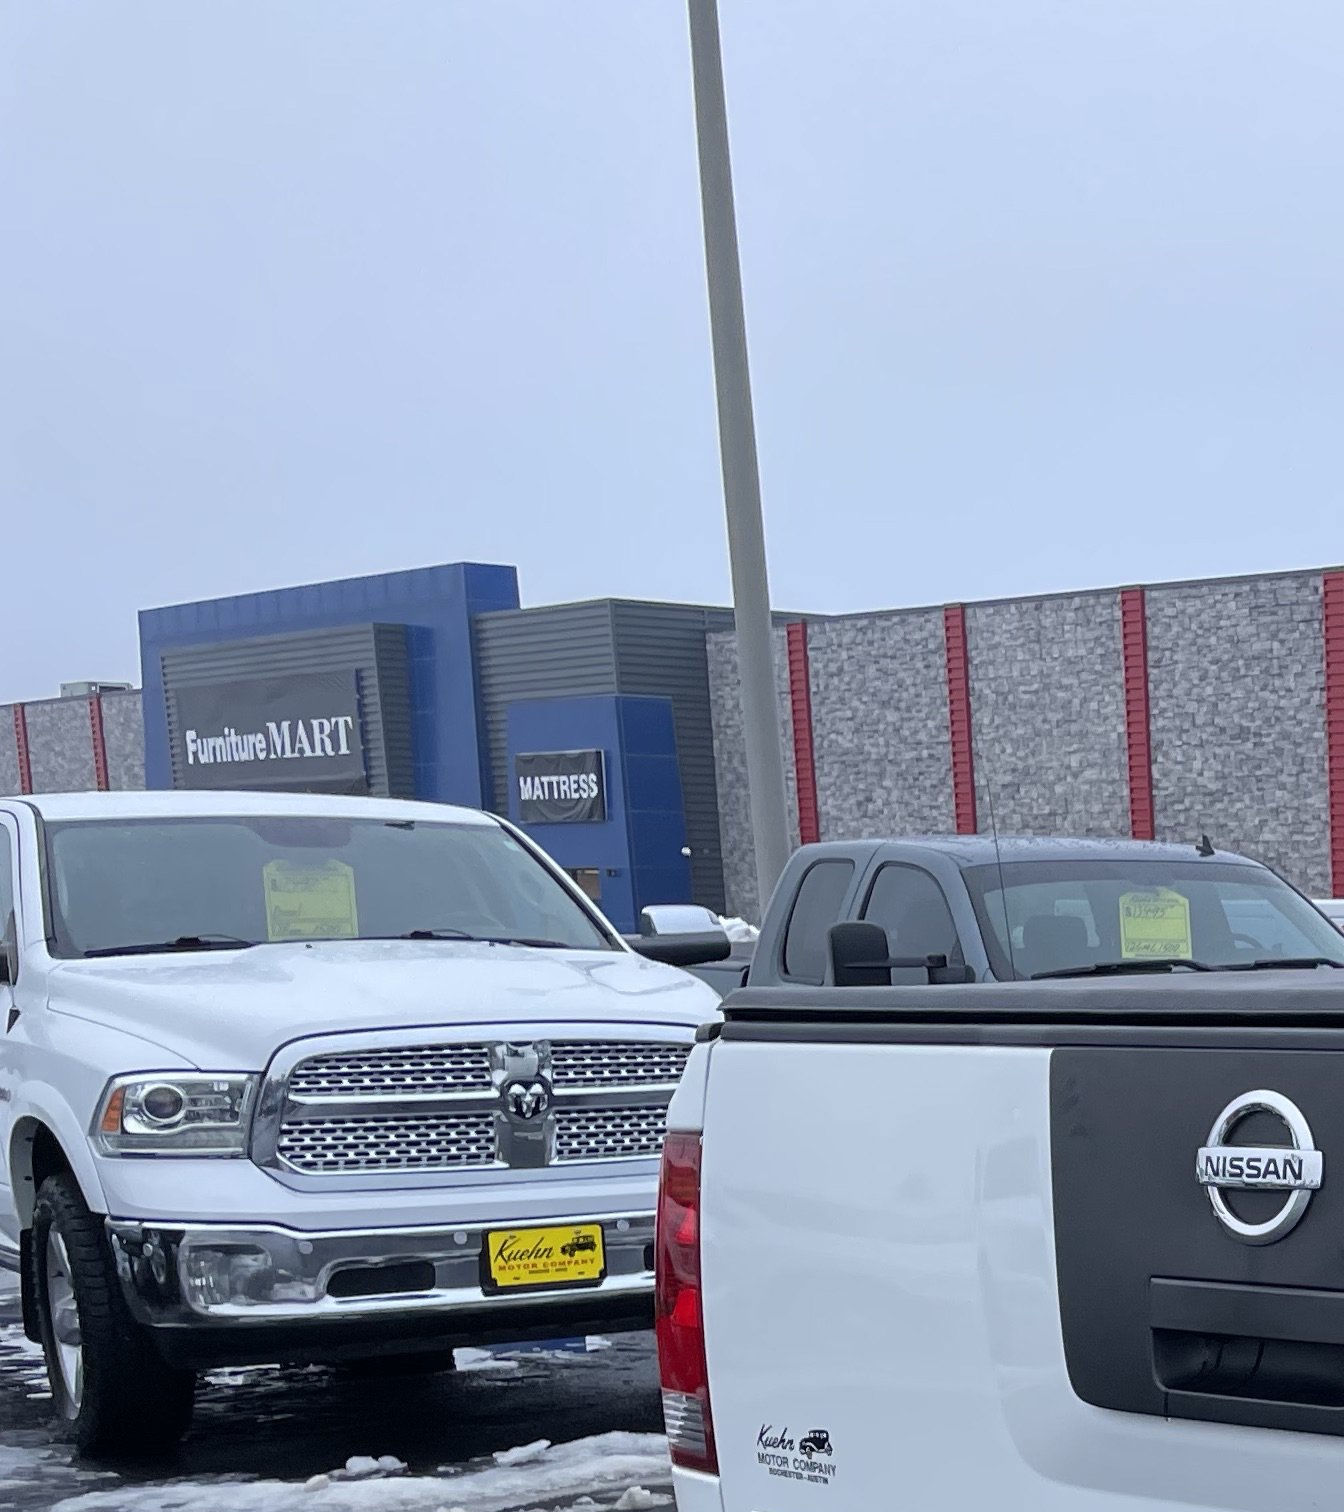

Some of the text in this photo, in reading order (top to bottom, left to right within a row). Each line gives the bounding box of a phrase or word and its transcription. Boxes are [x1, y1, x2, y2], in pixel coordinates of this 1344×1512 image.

[519, 772, 599, 801] MATTRESS
[1204, 1155, 1303, 1181] NISSAN
[493, 1236, 554, 1265] Kuehn
[498, 1262, 538, 1272] MOTOR
[543, 1258, 596, 1269] COMPANY
[757, 1423, 795, 1452] Kuehn
[757, 1451, 837, 1478] MOTOR COMPANY
